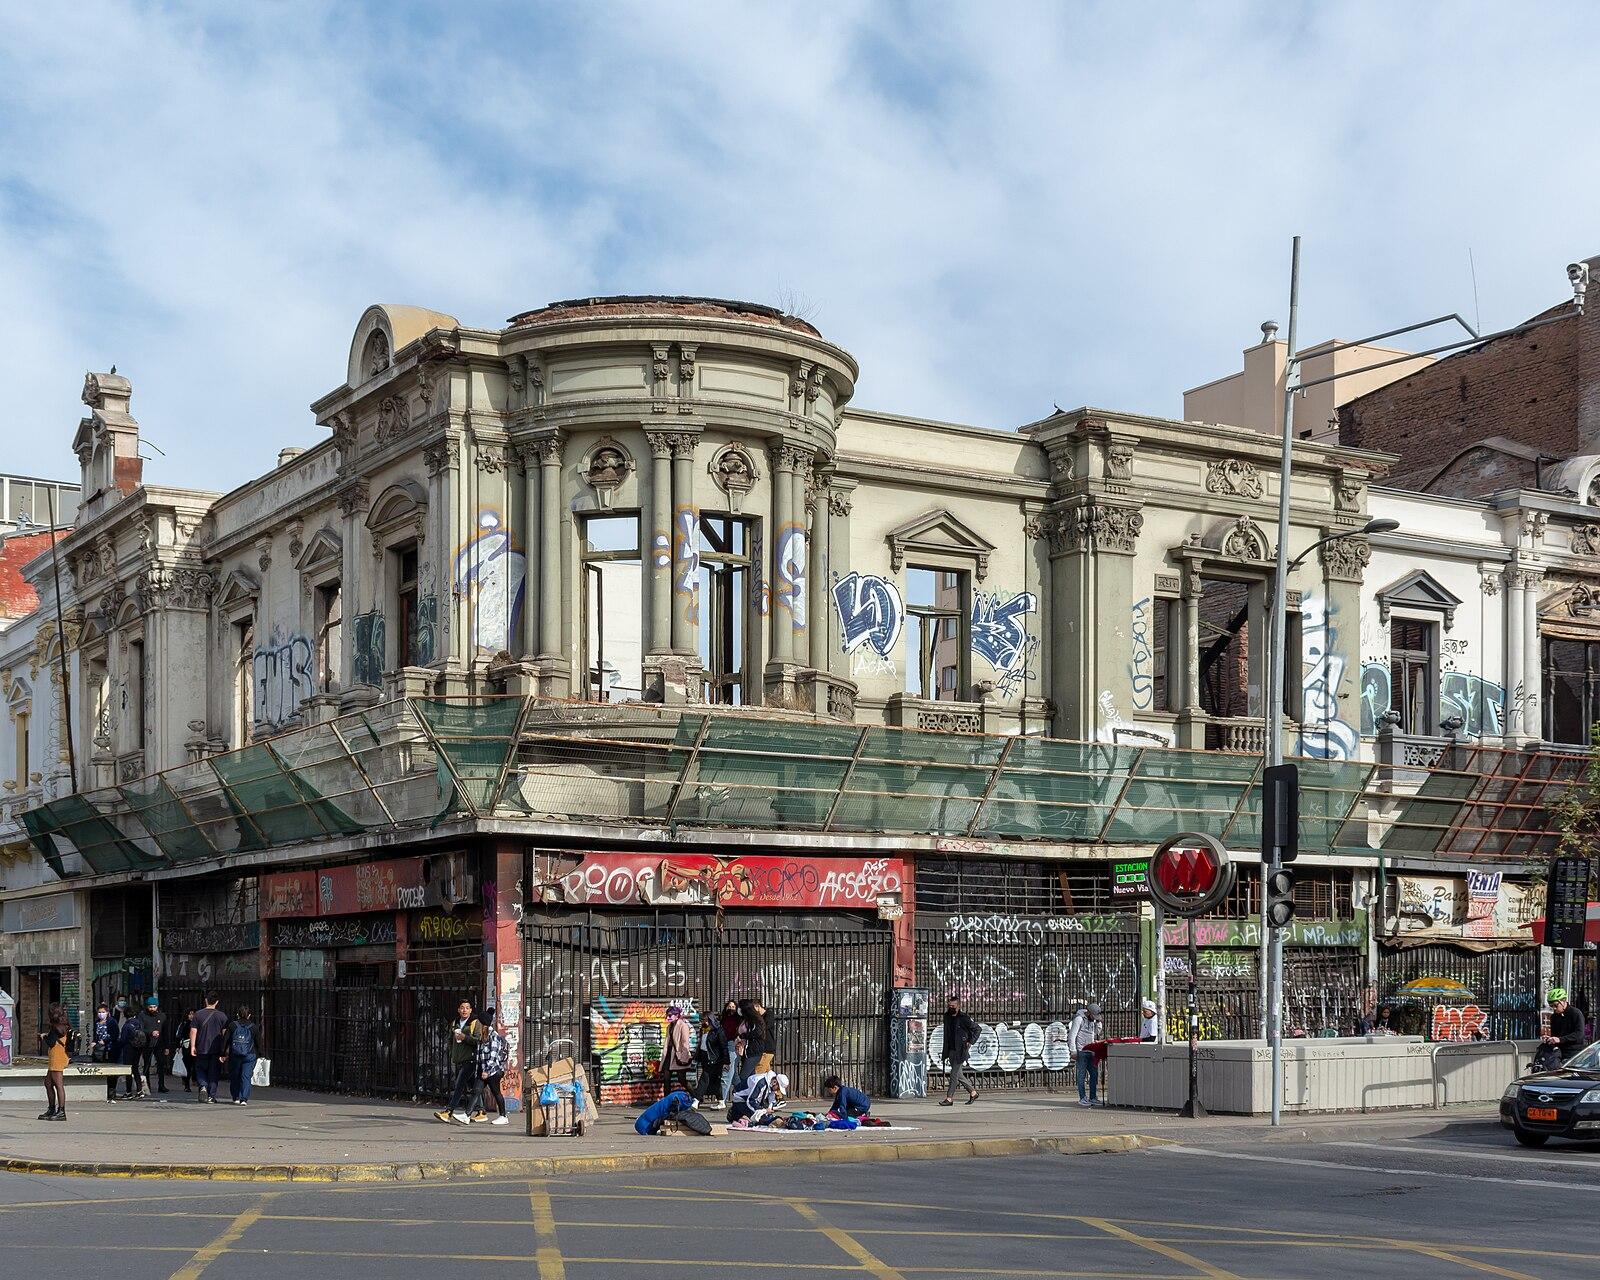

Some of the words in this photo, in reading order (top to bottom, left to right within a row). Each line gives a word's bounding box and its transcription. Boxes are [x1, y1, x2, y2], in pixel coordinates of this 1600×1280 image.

[1115, 862, 1148, 872] ESTACION
[1467, 871, 1501, 890] VENTA
[1113, 885, 1134, 894] Nuevo
